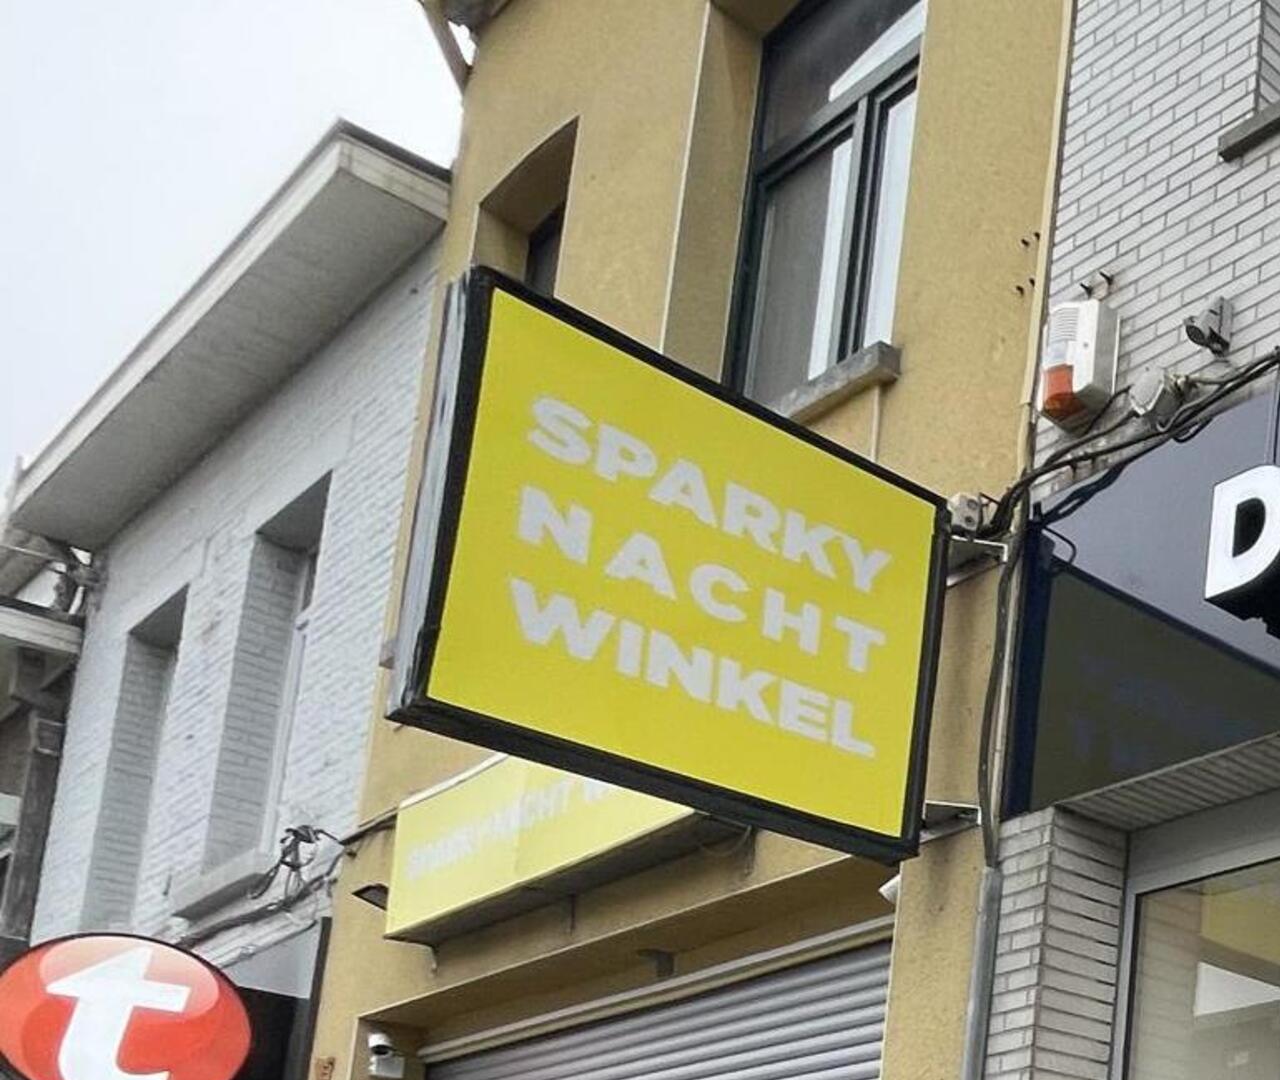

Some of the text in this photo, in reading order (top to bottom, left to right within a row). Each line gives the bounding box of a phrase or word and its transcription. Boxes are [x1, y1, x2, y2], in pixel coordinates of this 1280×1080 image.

[516, 485, 887, 674] NACHT
[526, 394, 892, 594] SPARKY
[508, 576, 876, 759] WINKEL
